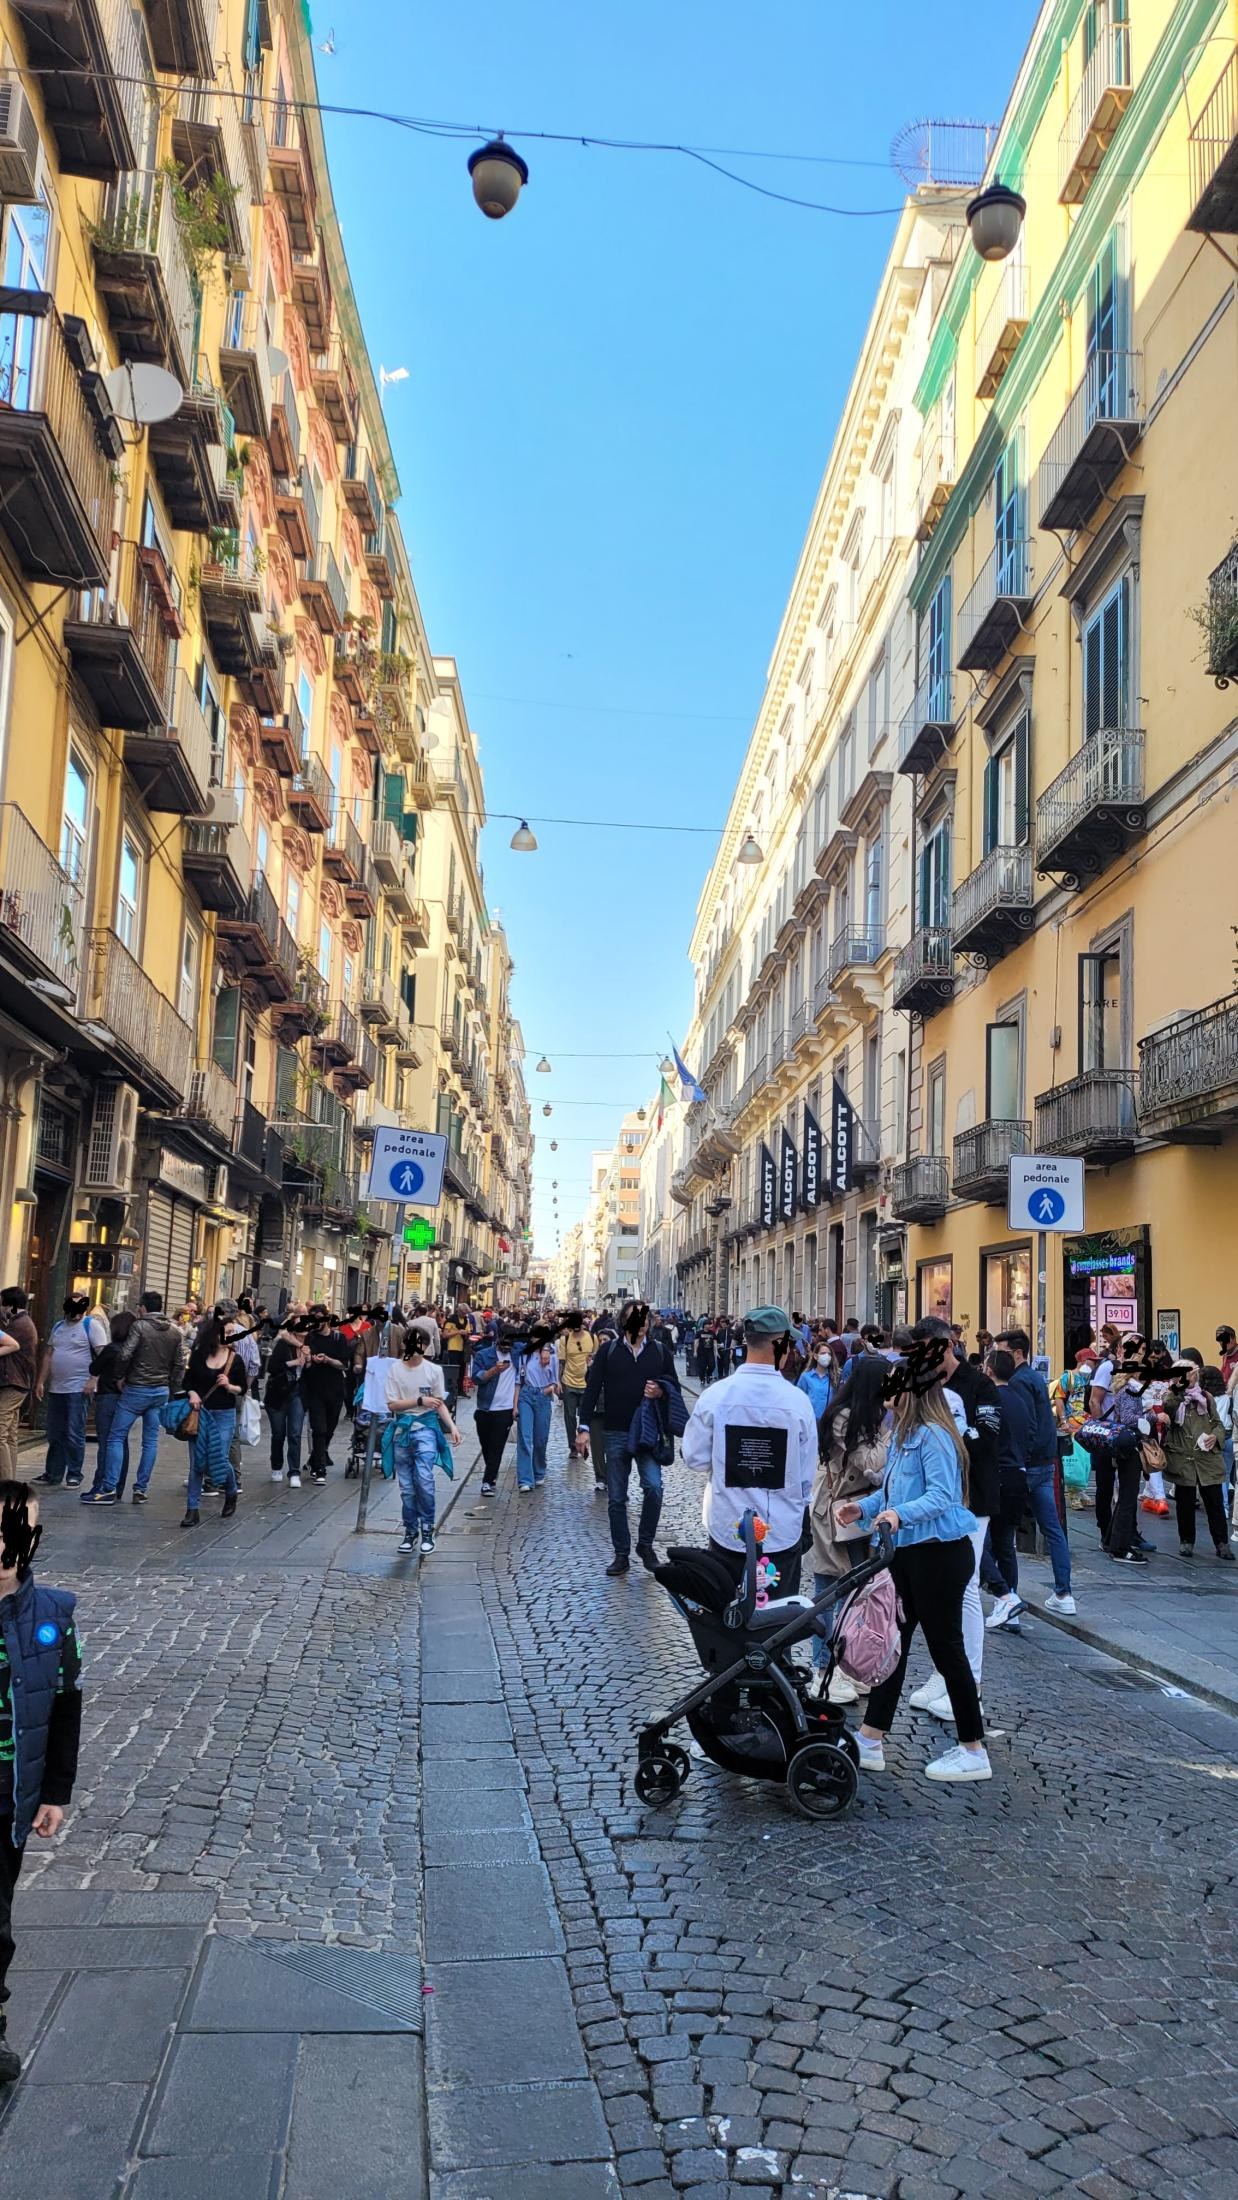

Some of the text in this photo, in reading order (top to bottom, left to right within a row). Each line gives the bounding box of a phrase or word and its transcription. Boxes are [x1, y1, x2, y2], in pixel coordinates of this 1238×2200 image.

[399, 1134, 424, 1144] area
[384, 1144, 436, 1158] pedonale
[836, 1103, 848, 1191] ALCOTT
[807, 1126, 817, 1205] ALCOTT
[1035, 1163, 1058, 1171] area
[783, 1146, 794, 1217] ALCOTT
[1023, 1173, 1070, 1184] pedonale
[763, 1160, 773, 1226] ALCOTT
[1107, 1309, 1130, 1319] 39.10
[1082, 1424, 1111, 1436] adidas
